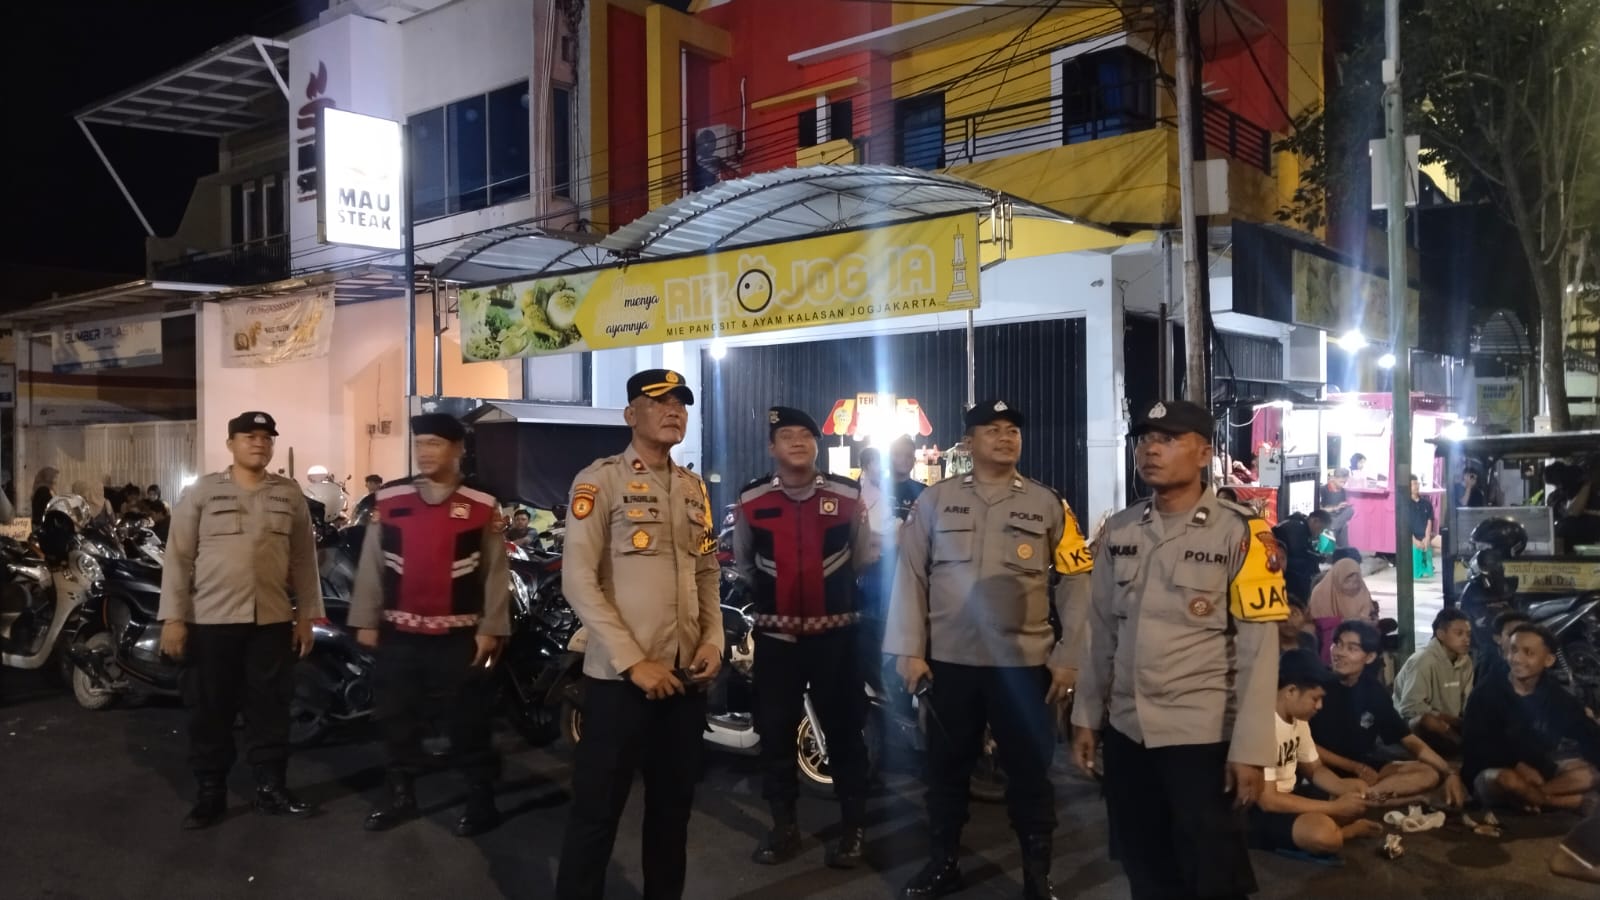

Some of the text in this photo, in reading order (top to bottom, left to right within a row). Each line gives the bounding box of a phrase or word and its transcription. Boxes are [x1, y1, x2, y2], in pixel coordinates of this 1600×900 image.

[338, 188, 390, 212] MAU
[338, 210, 391, 231] STEAK
[624, 295, 660, 310] mienya
[666, 326, 685, 336] MIE
[689, 321, 736, 334] PANGSIT
[741, 319, 748, 328] &
[753, 315, 783, 327] AYAM
[788, 308, 844, 323] KALASAN
[849, 297, 937, 316] JOGJAKARTA
[605, 321, 649, 338] ayamnya
[859, 396, 874, 405] TEH
[943, 505, 971, 514] ARIE
[1009, 511, 1044, 522] POLRI
[1184, 550, 1228, 565] POLRI
